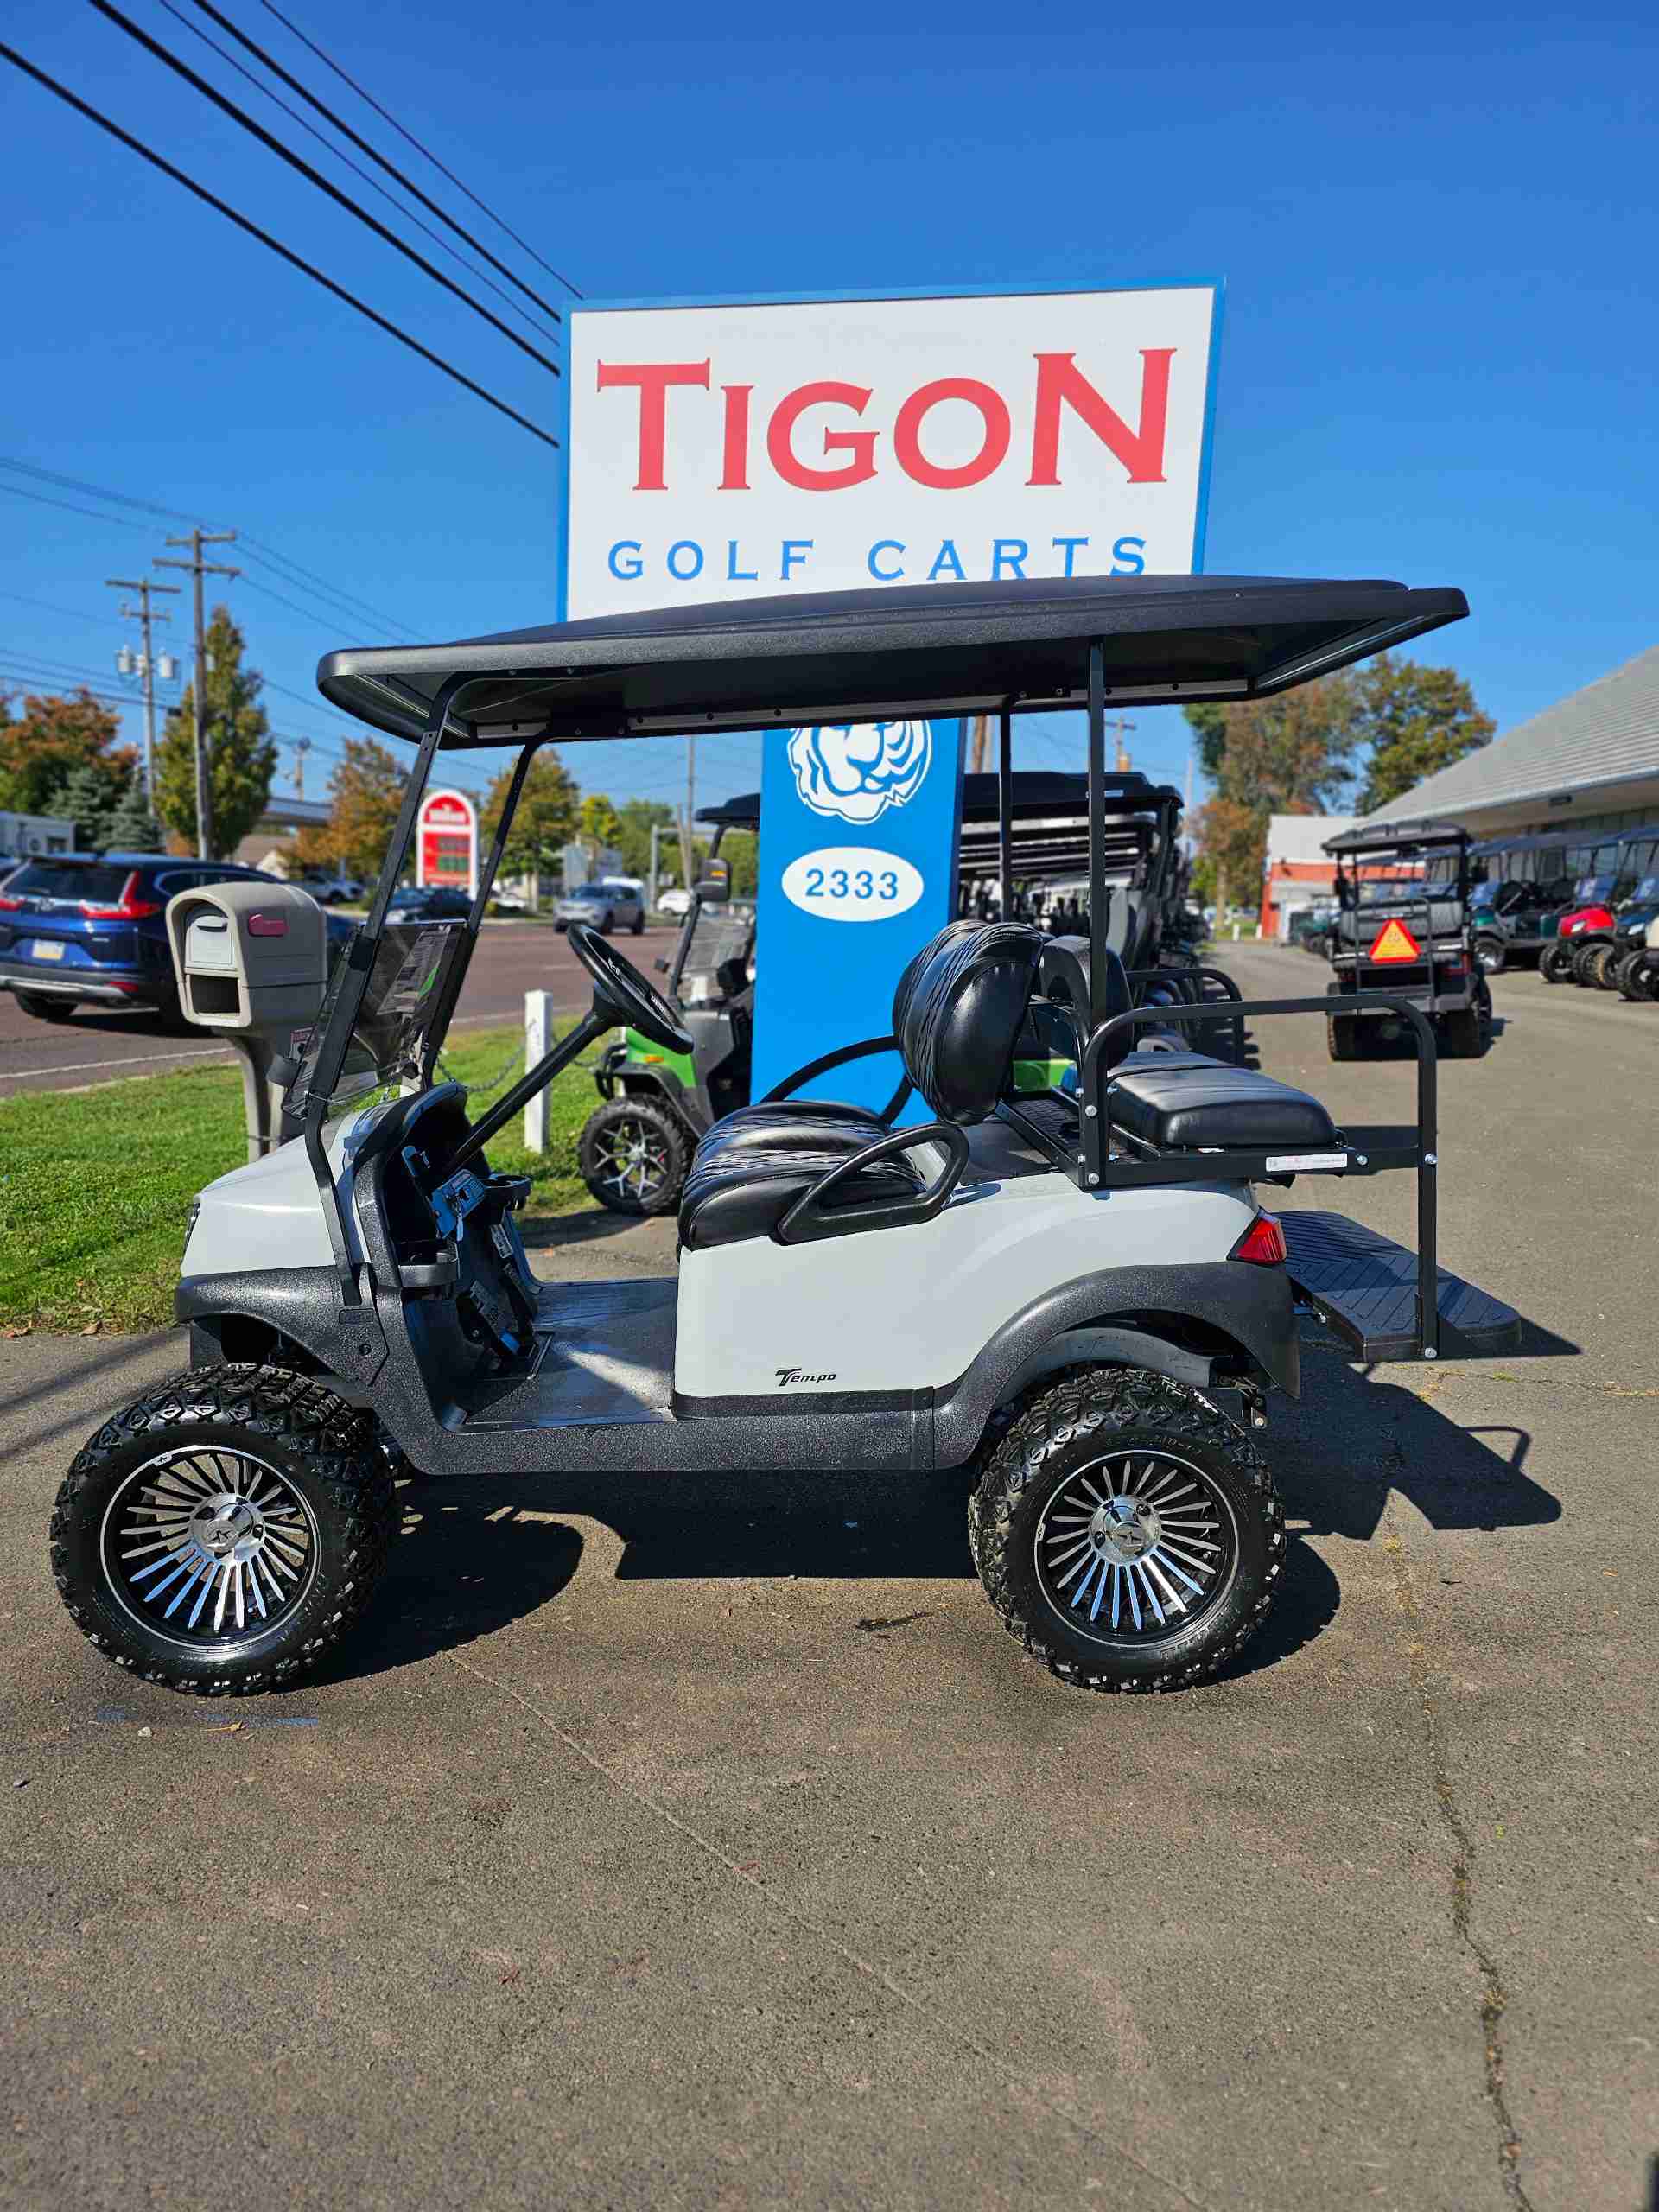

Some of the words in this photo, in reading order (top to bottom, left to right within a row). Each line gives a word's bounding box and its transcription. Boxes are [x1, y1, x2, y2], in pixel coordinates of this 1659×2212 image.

[597, 347, 1178, 492] TIGON
[608, 539, 814, 581] GOLF
[868, 537, 1147, 581] CARTS
[805, 868, 898, 899] 2333
[775, 1368, 837, 1386] Tempo
